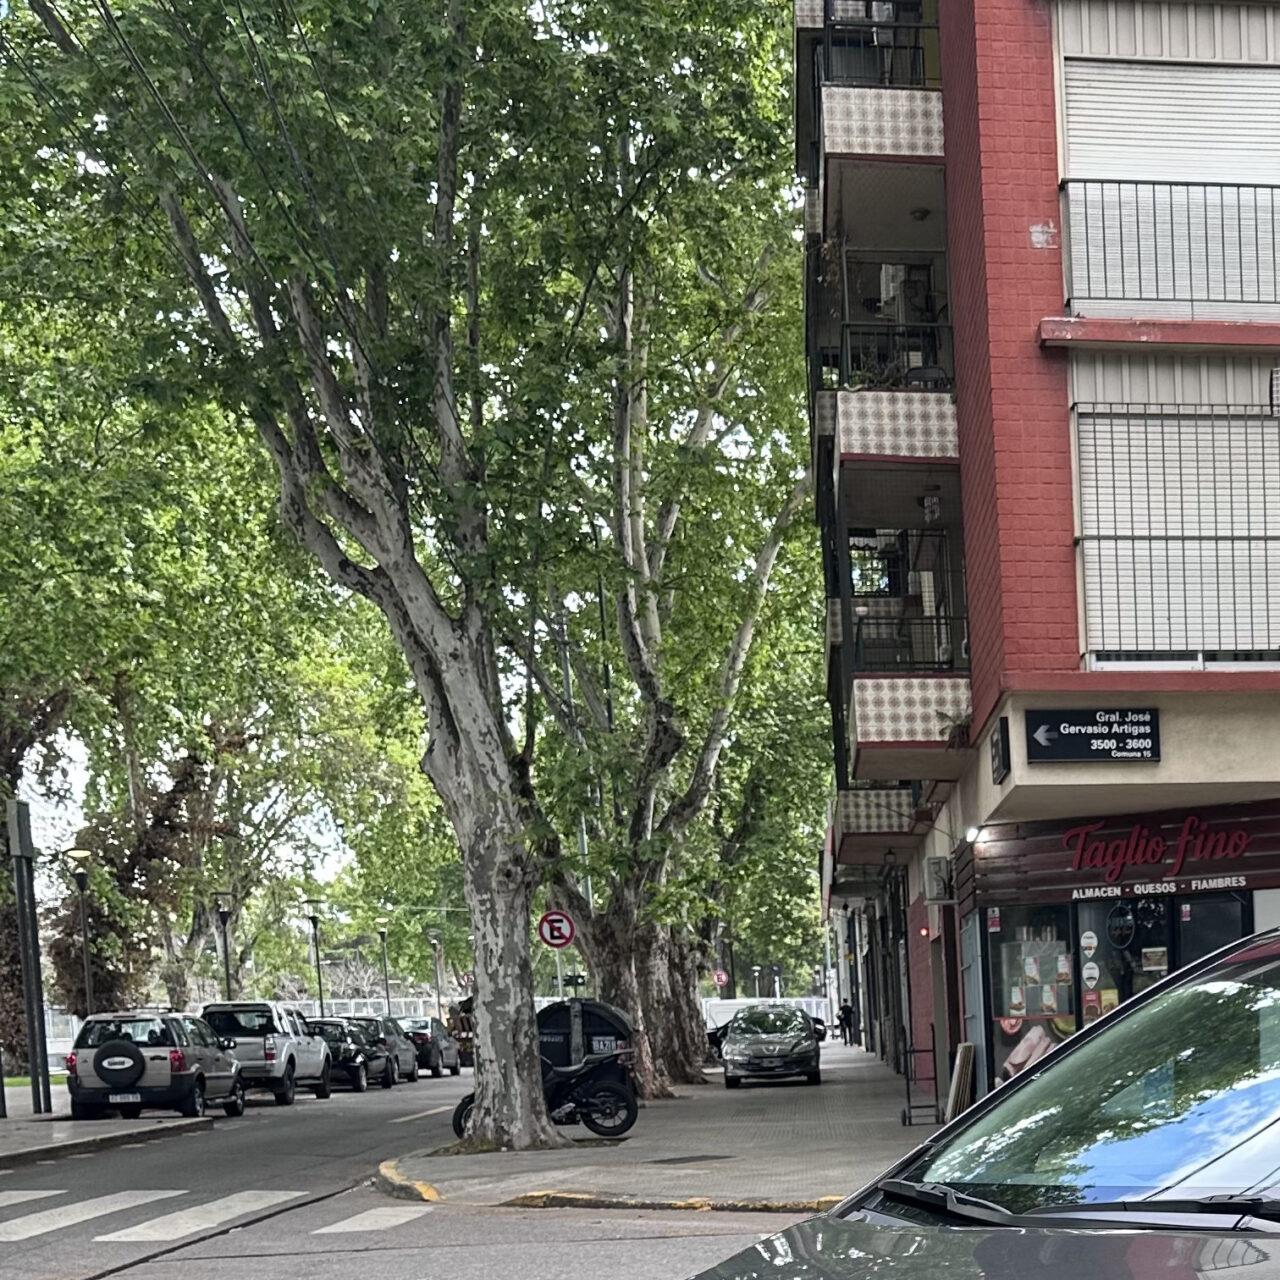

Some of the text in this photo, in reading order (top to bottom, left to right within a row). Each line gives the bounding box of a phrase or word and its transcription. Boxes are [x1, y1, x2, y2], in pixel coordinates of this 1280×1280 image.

[1096, 711, 1151, 722] Gral. José
[1060, 723, 1151, 735] Gervasio Artigas
[1090, 739, 1117, 750] 3500
[1125, 739, 1152, 749] 3600
[1111, 750, 1151, 758] Comuna 15
[1063, 816, 1253, 884] Taglio fino
[1072, 886, 1122, 899] ALMACEN
[1134, 883, 1177, 895] QUESOS
[1191, 876, 1247, 890] FIAMBRES
